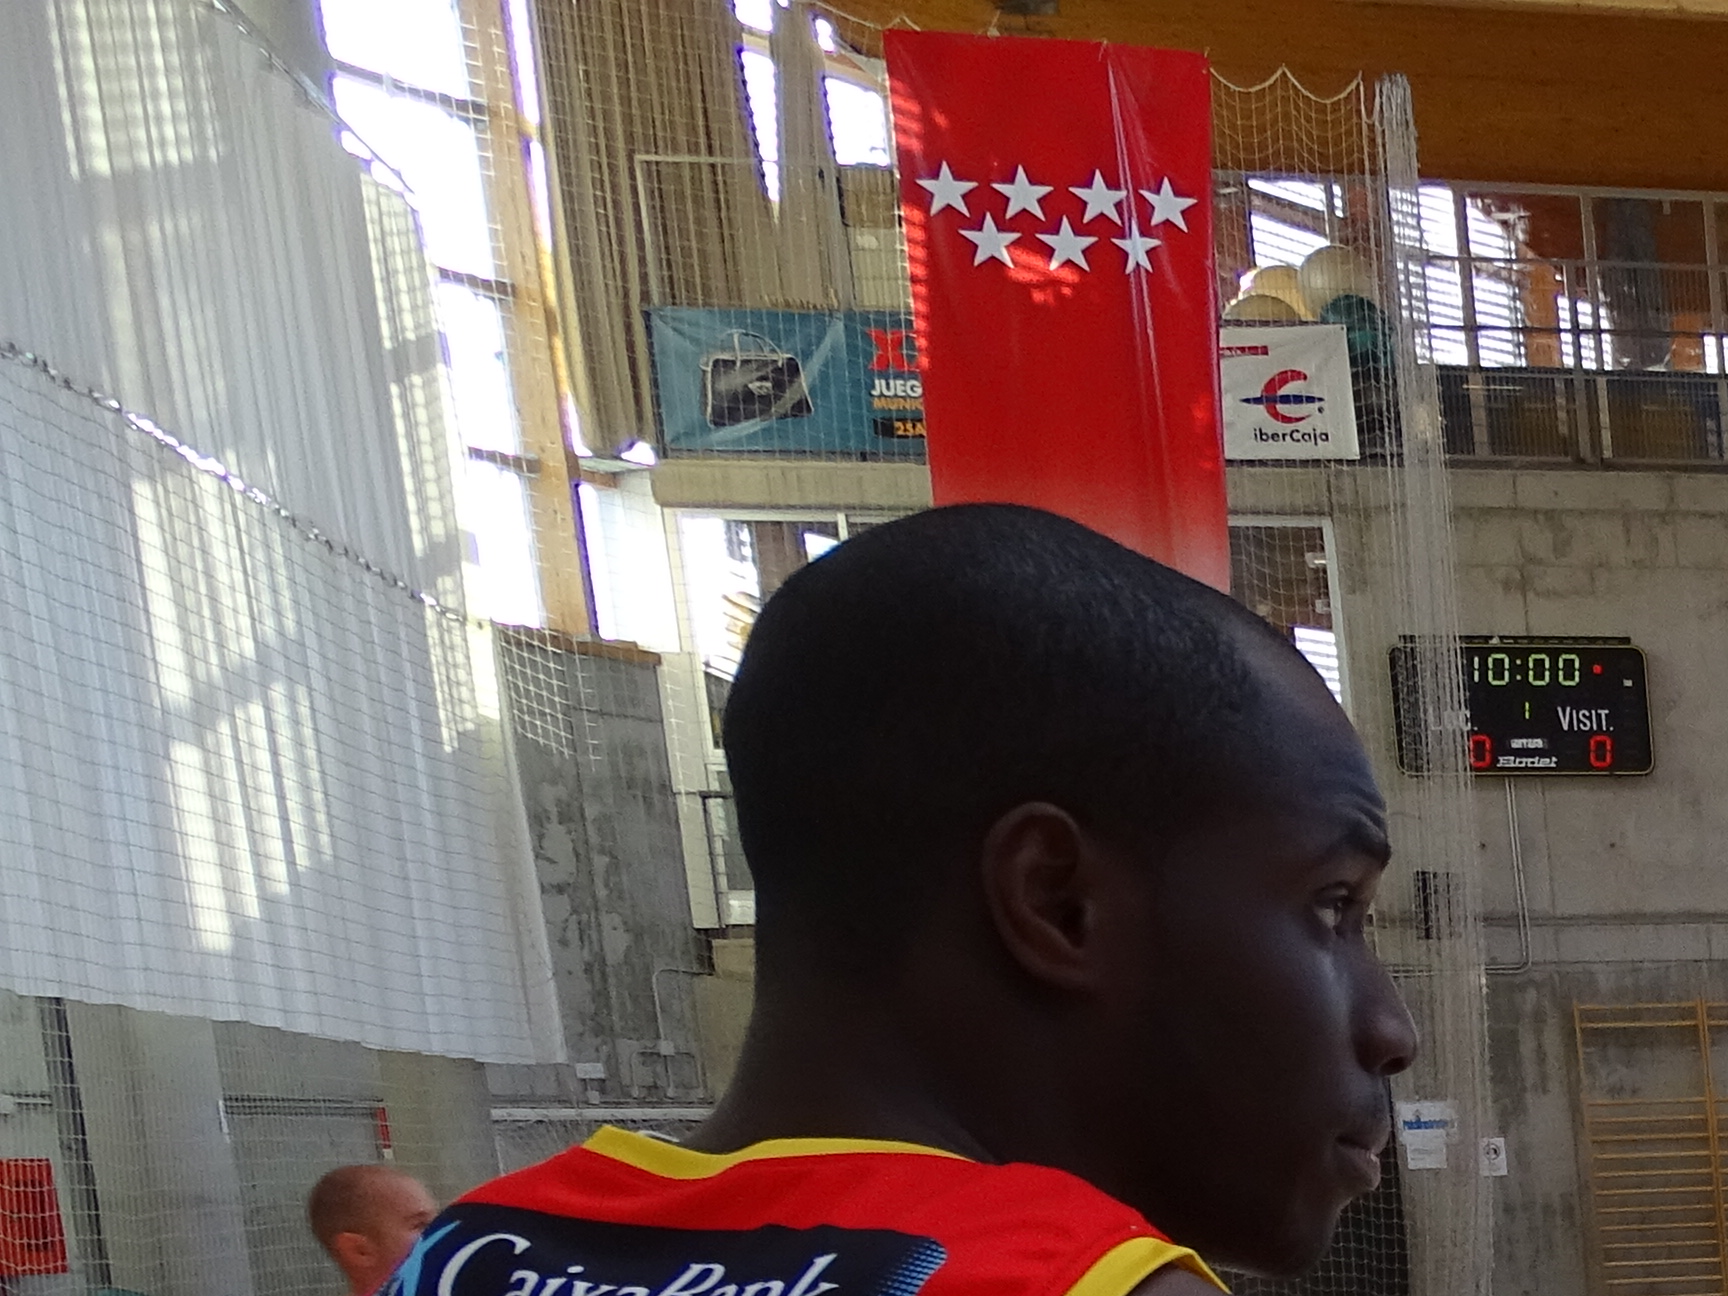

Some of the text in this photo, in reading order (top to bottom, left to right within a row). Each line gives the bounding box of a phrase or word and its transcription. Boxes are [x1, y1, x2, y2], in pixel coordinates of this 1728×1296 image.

[1253, 426, 1330, 447] iberCaja
[1473, 653, 1580, 686] 10:00
[1557, 706, 1614, 731] VISIT.
[1469, 734, 1492, 768] 0
[1589, 734, 1612, 768] 0
